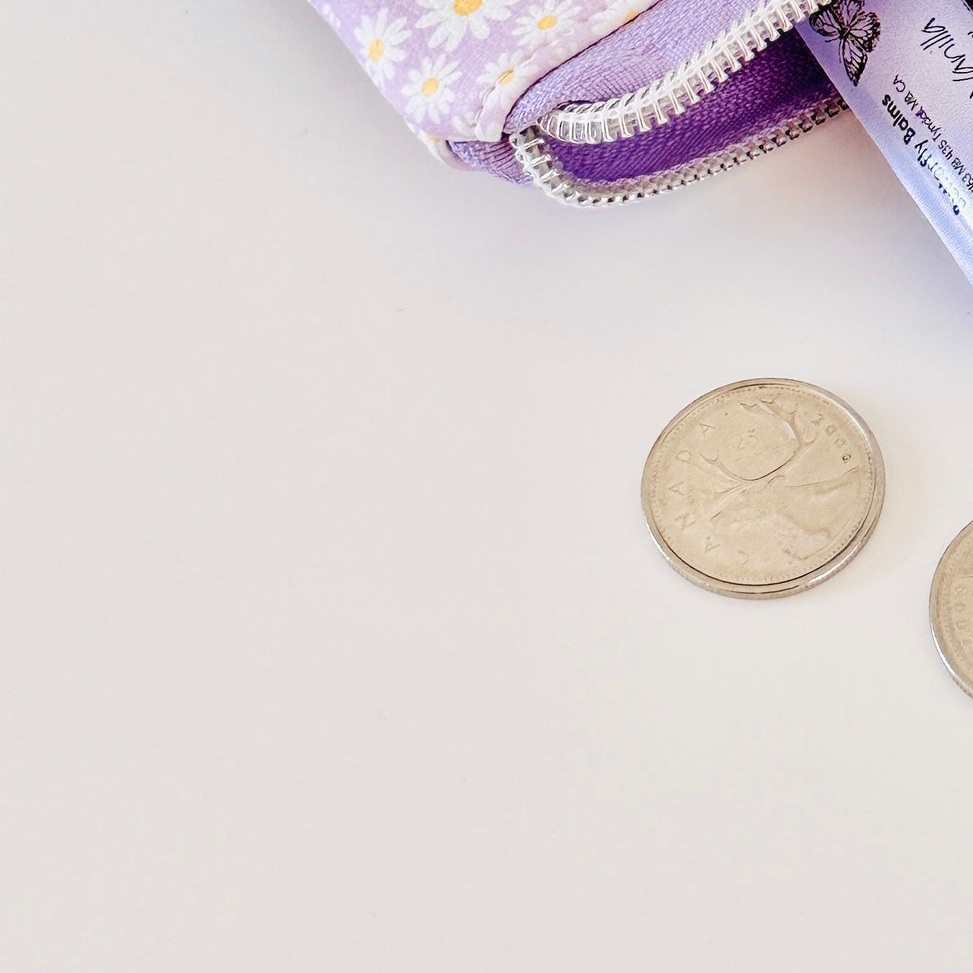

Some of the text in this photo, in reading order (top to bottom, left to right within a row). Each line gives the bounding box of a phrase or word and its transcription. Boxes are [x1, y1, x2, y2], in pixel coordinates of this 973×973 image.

[892, 74, 906, 93] CA
[881, 94, 916, 145] Balms
[937, 139, 953, 160] 435
[667, 422, 750, 565] CANADA
